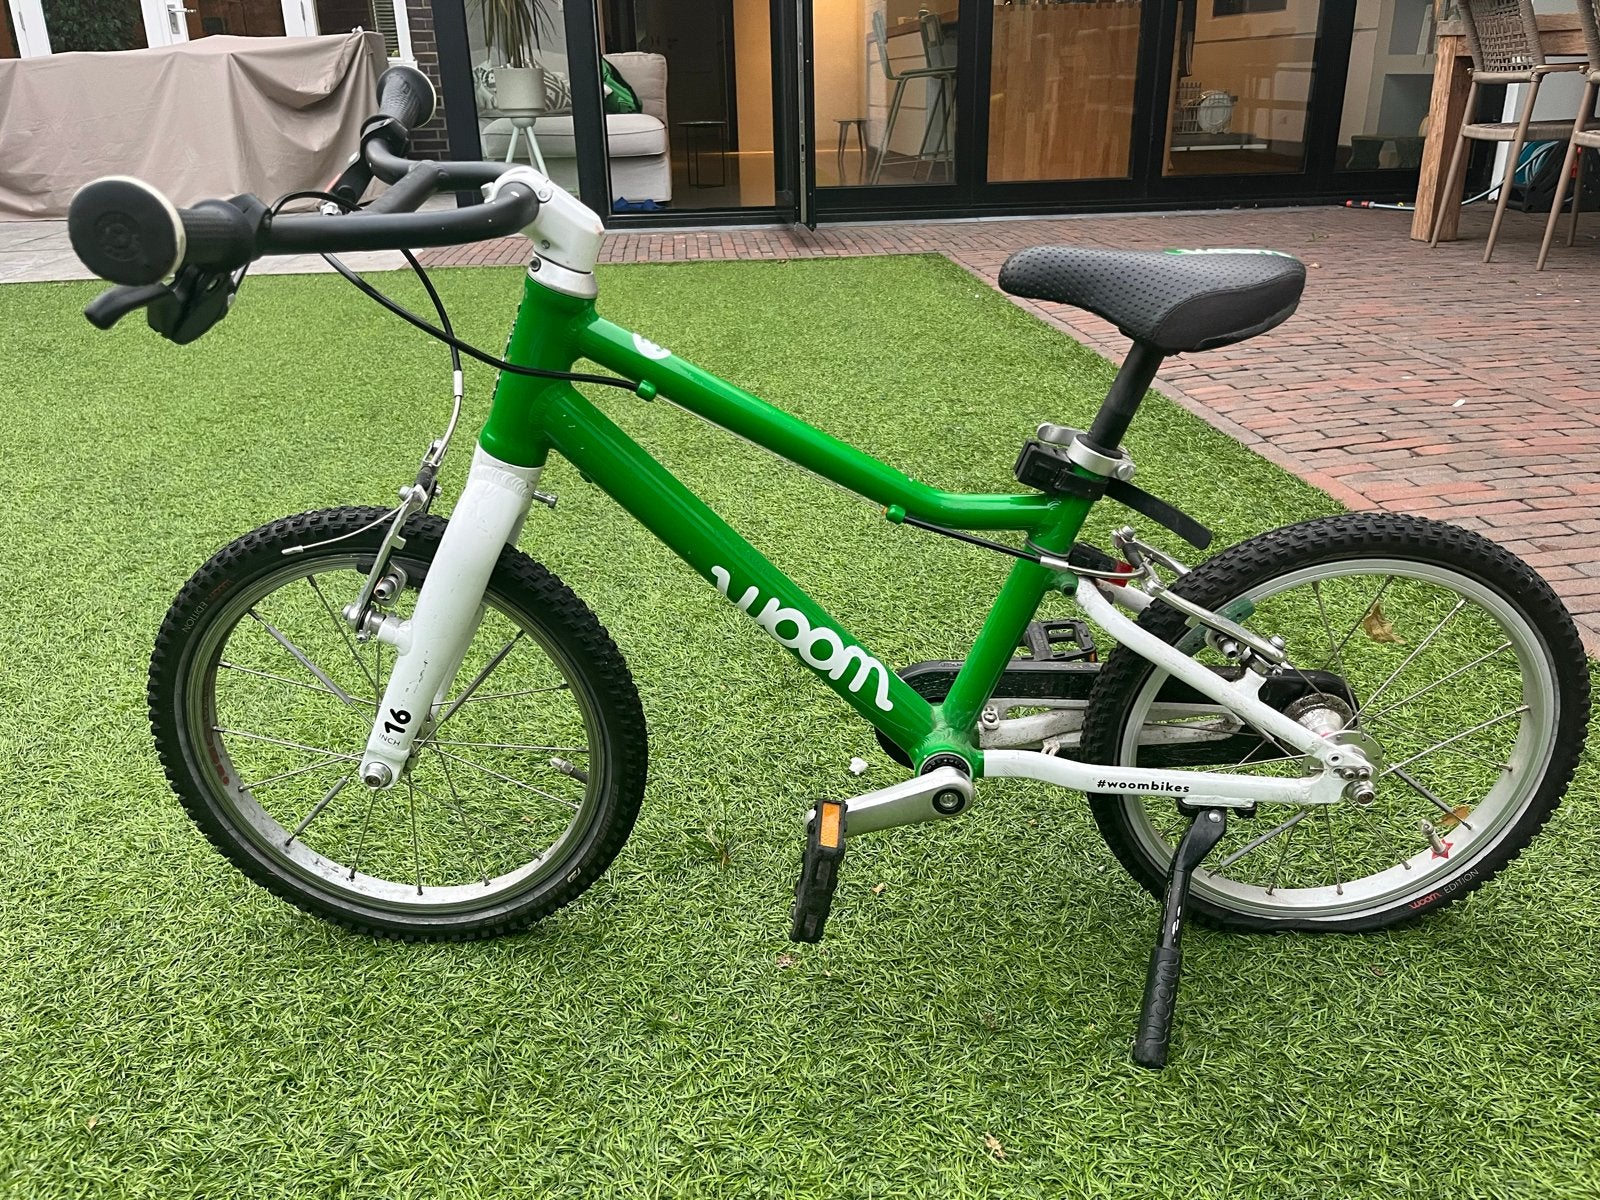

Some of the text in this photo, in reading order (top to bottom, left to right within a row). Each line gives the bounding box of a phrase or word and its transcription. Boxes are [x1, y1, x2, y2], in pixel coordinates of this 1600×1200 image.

[182, 601, 208, 632] EDITION
[711, 565, 894, 712] woom
[384, 708, 411, 733] 16
[379, 733, 401, 747] INCH
[1097, 779, 1190, 793] #woombikes
[1408, 868, 1479, 909] woom EDITION
